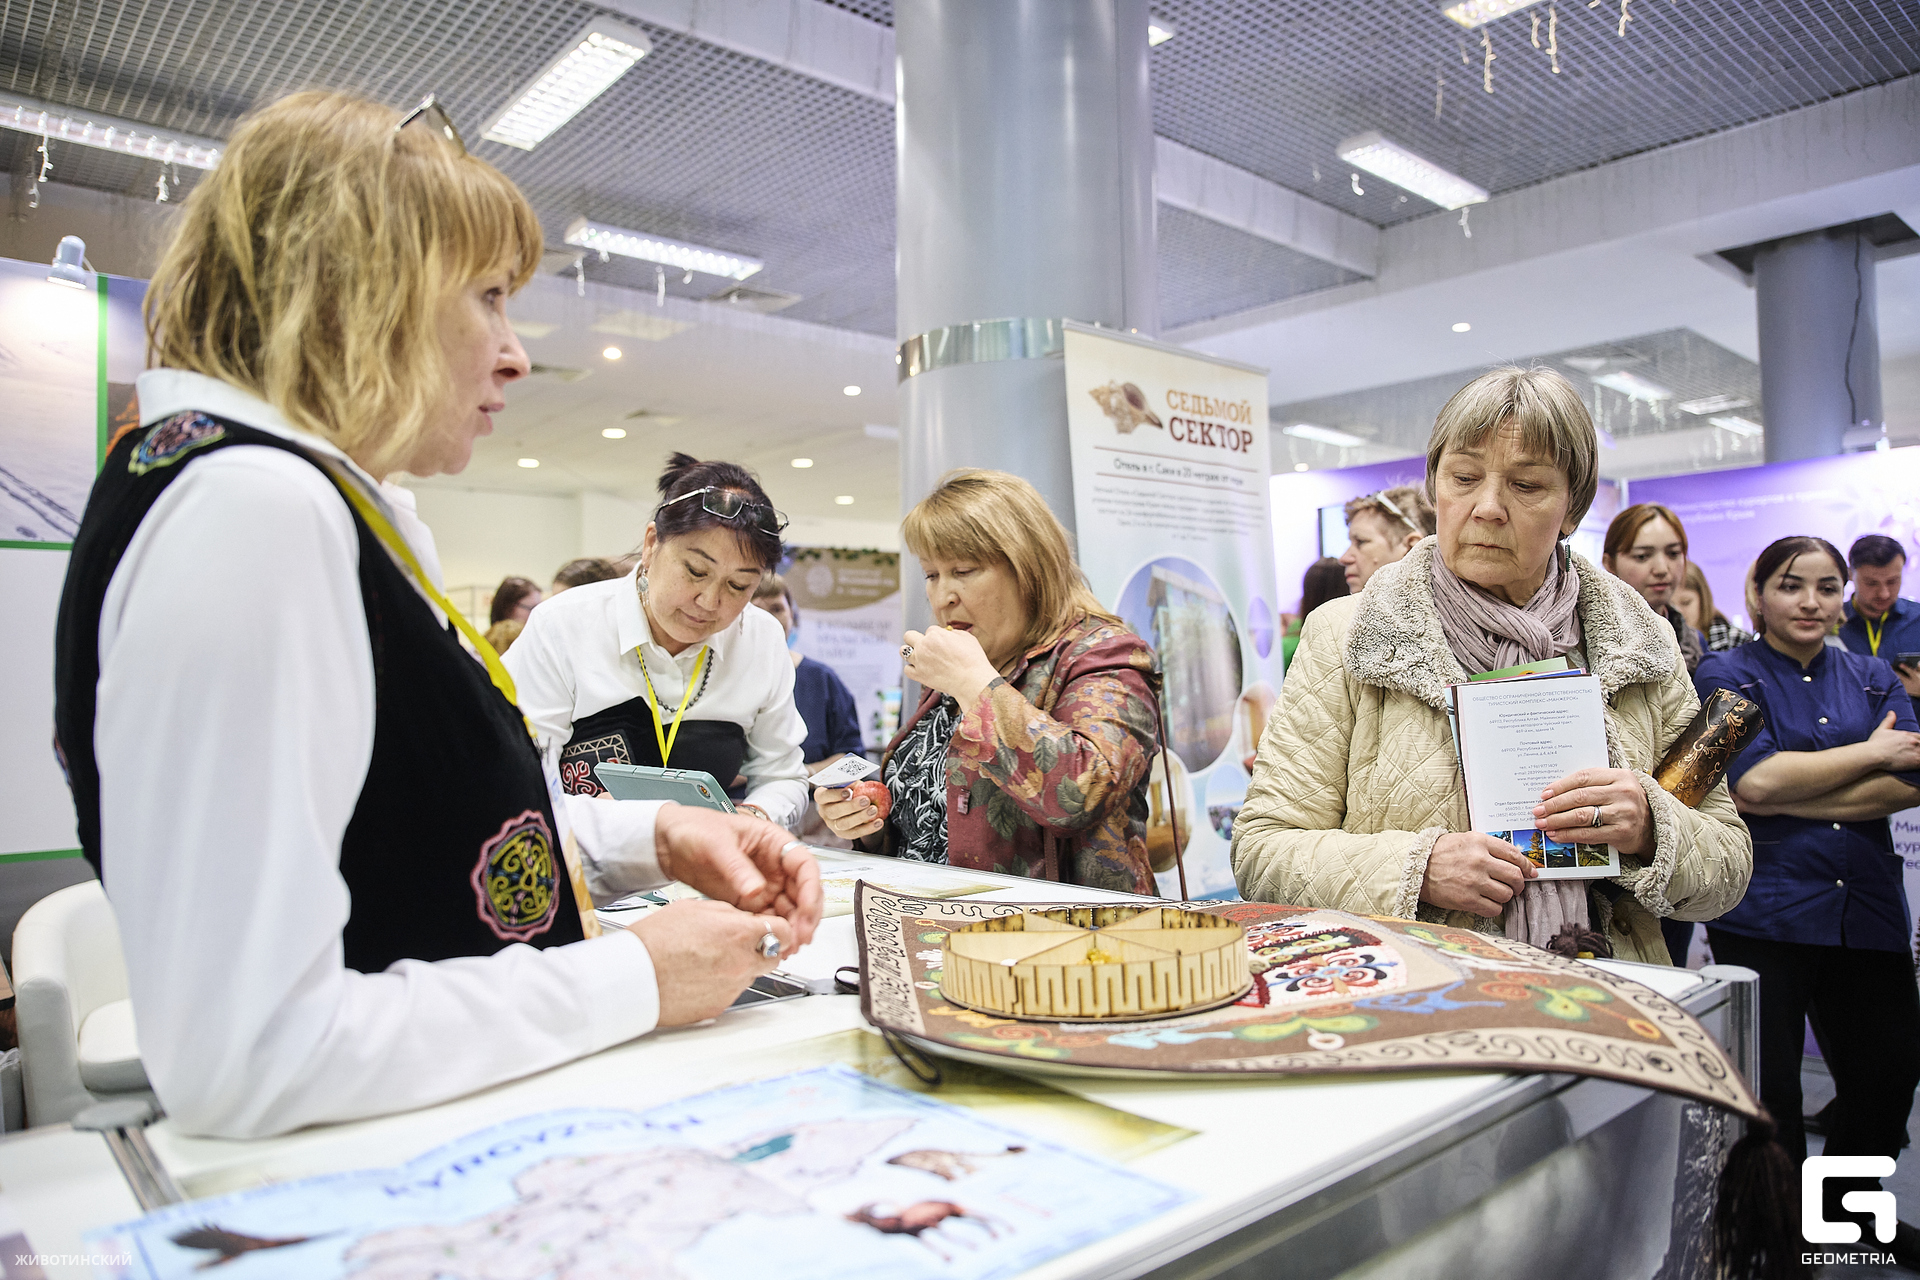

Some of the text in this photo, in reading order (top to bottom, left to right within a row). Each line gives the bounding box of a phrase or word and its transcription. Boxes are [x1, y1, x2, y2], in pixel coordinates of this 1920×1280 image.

[1166, 389, 1252, 425] СЕДЬМОЙ
[1169, 416, 1253, 454] СЕКТОР
[1503, 692, 1541, 700] ОГРАНИЧЕННОЙ
[1542, 689, 1592, 697] ОТВЕТСТВЕННОСТЬЮ
[1895, 820, 1920, 834] Ми
